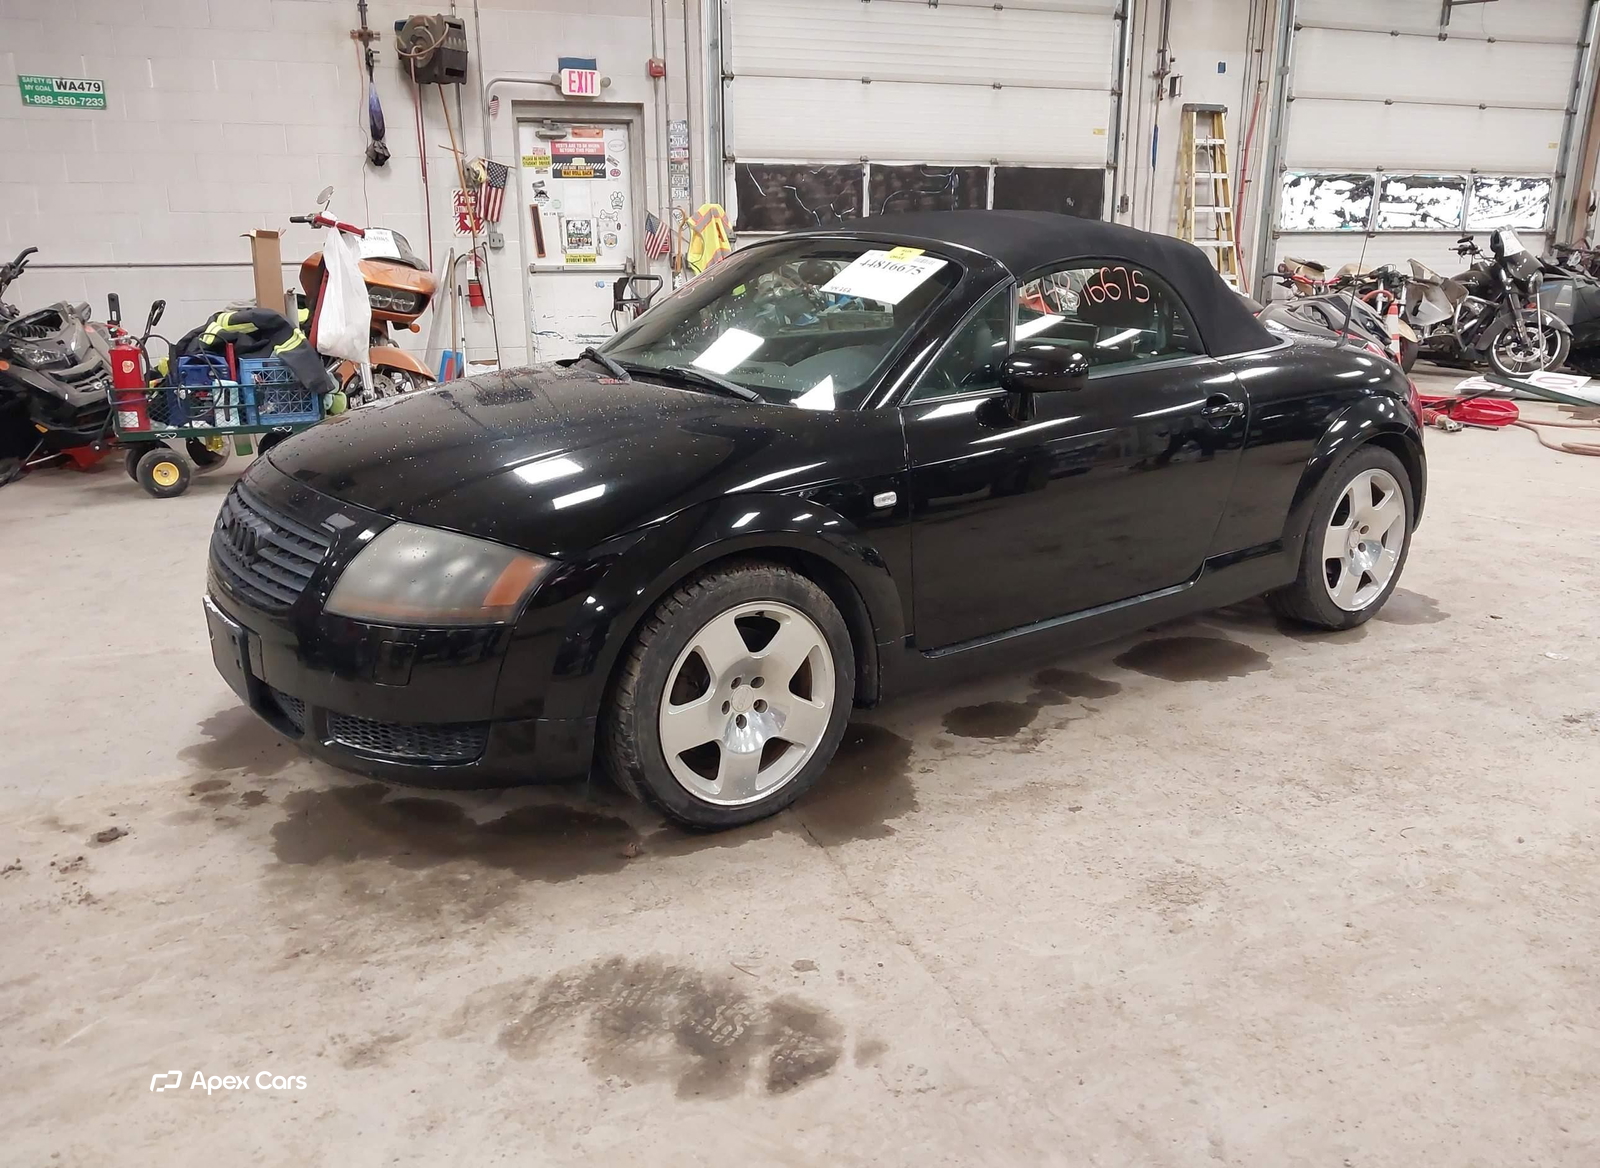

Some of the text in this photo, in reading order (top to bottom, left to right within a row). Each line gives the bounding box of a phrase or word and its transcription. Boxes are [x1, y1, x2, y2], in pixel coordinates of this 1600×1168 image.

[21, 76, 45, 84] SAFETY
[55, 80, 101, 92] WA479
[568, 70, 596, 94] EXIT
[24, 94, 104, 106] 1-888-550-7233
[859, 258, 925, 276] 44816675
[1020, 266, 1150, 316] 44816675
